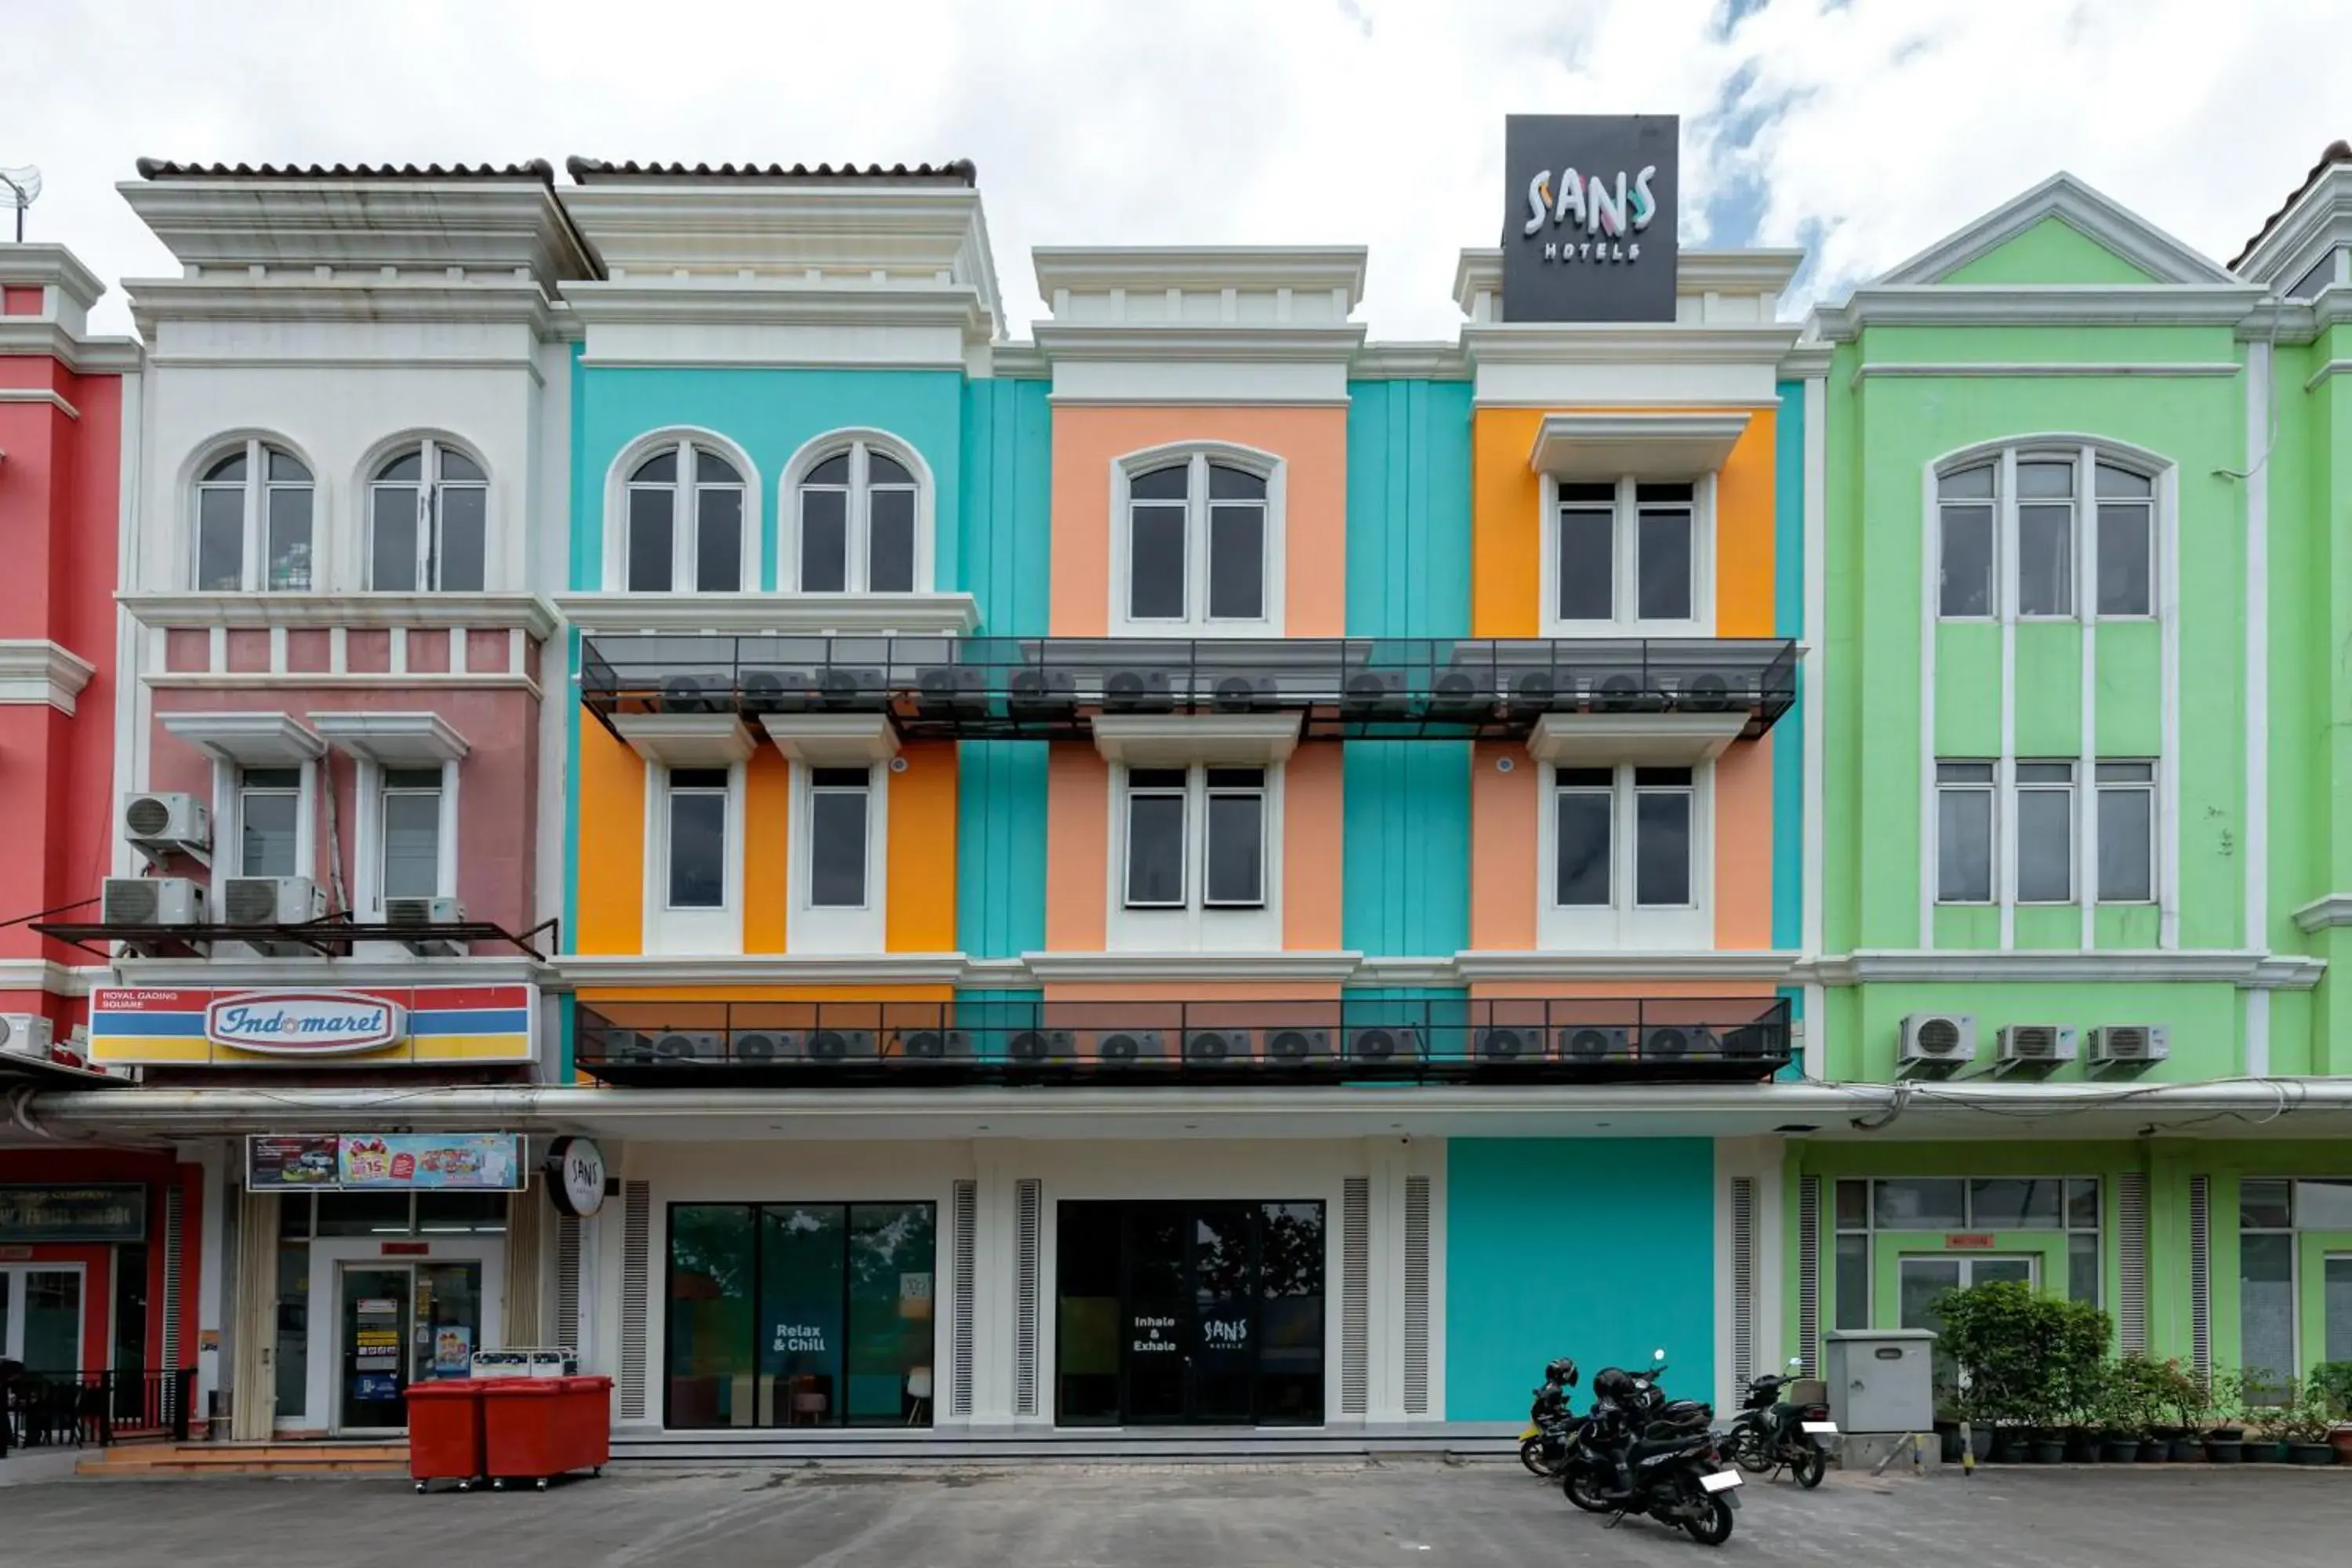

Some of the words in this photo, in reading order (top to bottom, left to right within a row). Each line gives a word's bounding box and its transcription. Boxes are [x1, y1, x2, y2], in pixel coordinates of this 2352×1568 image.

[1524, 165, 1657, 237] SANS
[1544, 242, 1641, 262] HOTELS
[103, 991, 136, 1000] ROYAL
[137, 992, 178, 1001] GADING
[103, 1000, 144, 1009] SQUARE
[219, 1007, 383, 1036] Indomaret
[572, 1158, 597, 1187] SANS
[1134, 1316, 1175, 1327] Inhale
[777, 1323, 821, 1337] Relax
[1149, 1328, 1160, 1339] &
[1204, 1319, 1247, 1341] SANS
[773, 1338, 786, 1351] &
[788, 1338, 826, 1351] Chill
[1134, 1340, 1177, 1351] Exhale
